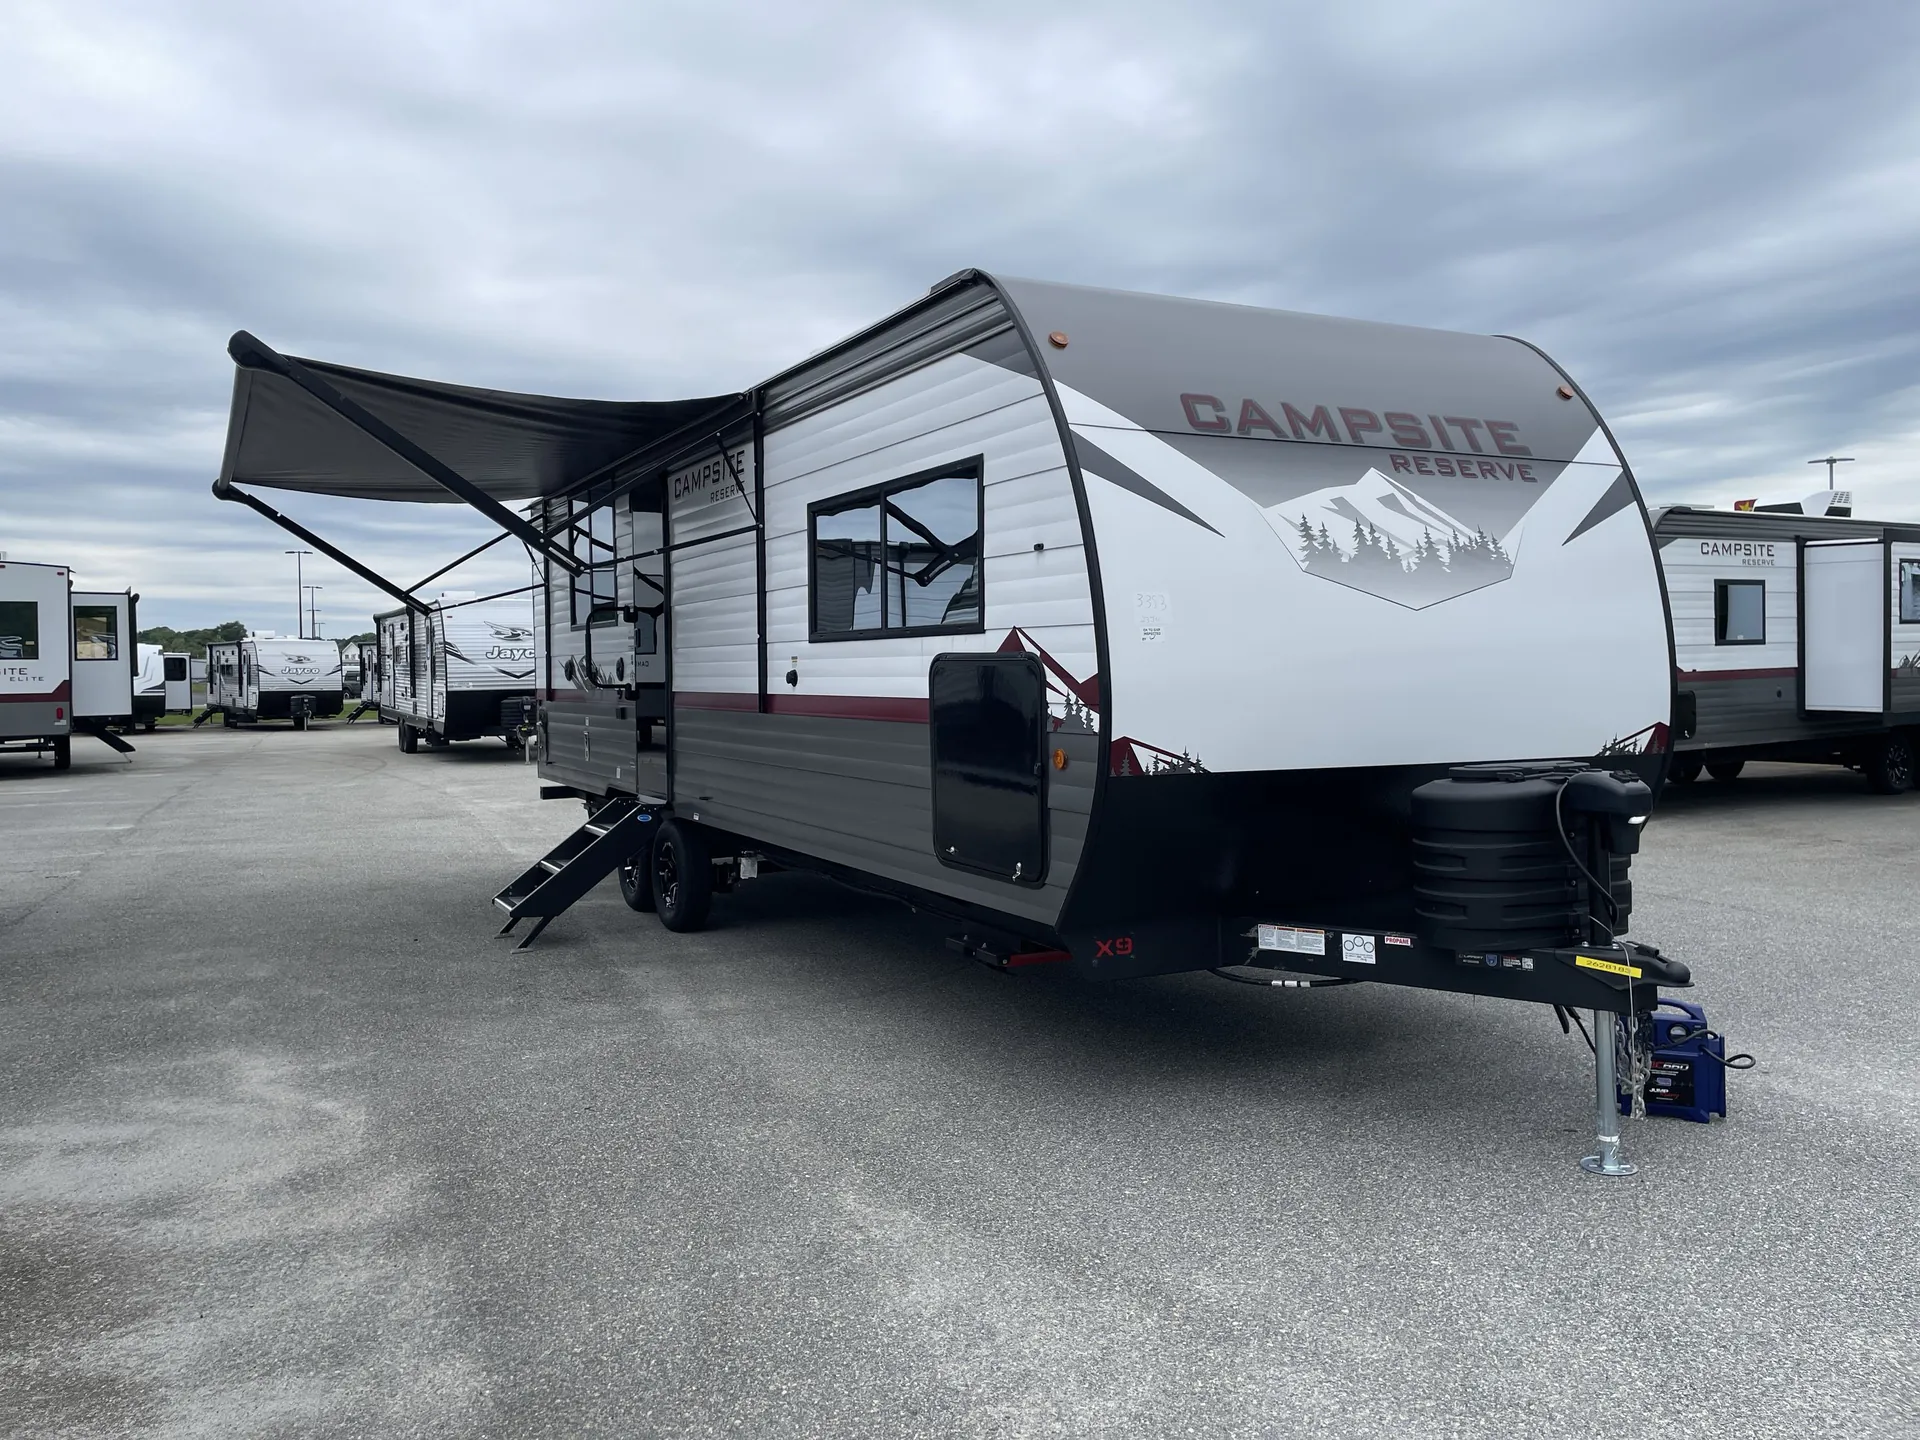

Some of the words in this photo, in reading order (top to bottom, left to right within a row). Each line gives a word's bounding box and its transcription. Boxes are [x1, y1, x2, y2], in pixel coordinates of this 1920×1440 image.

[1180, 392, 1532, 457] CAMPSITE
[674, 450, 745, 500] CAMPSITE
[1389, 453, 1538, 483] RESERVE
[710, 480, 745, 503] RESERV
[1700, 542, 1774, 556] CAMPSITE
[485, 646, 535, 661] Jayc
[0, 667, 27, 675] ITE
[281, 666, 320, 675] Jayco
[1096, 937, 1132, 957] X9
[1386, 937, 1410, 945] PROPANE
